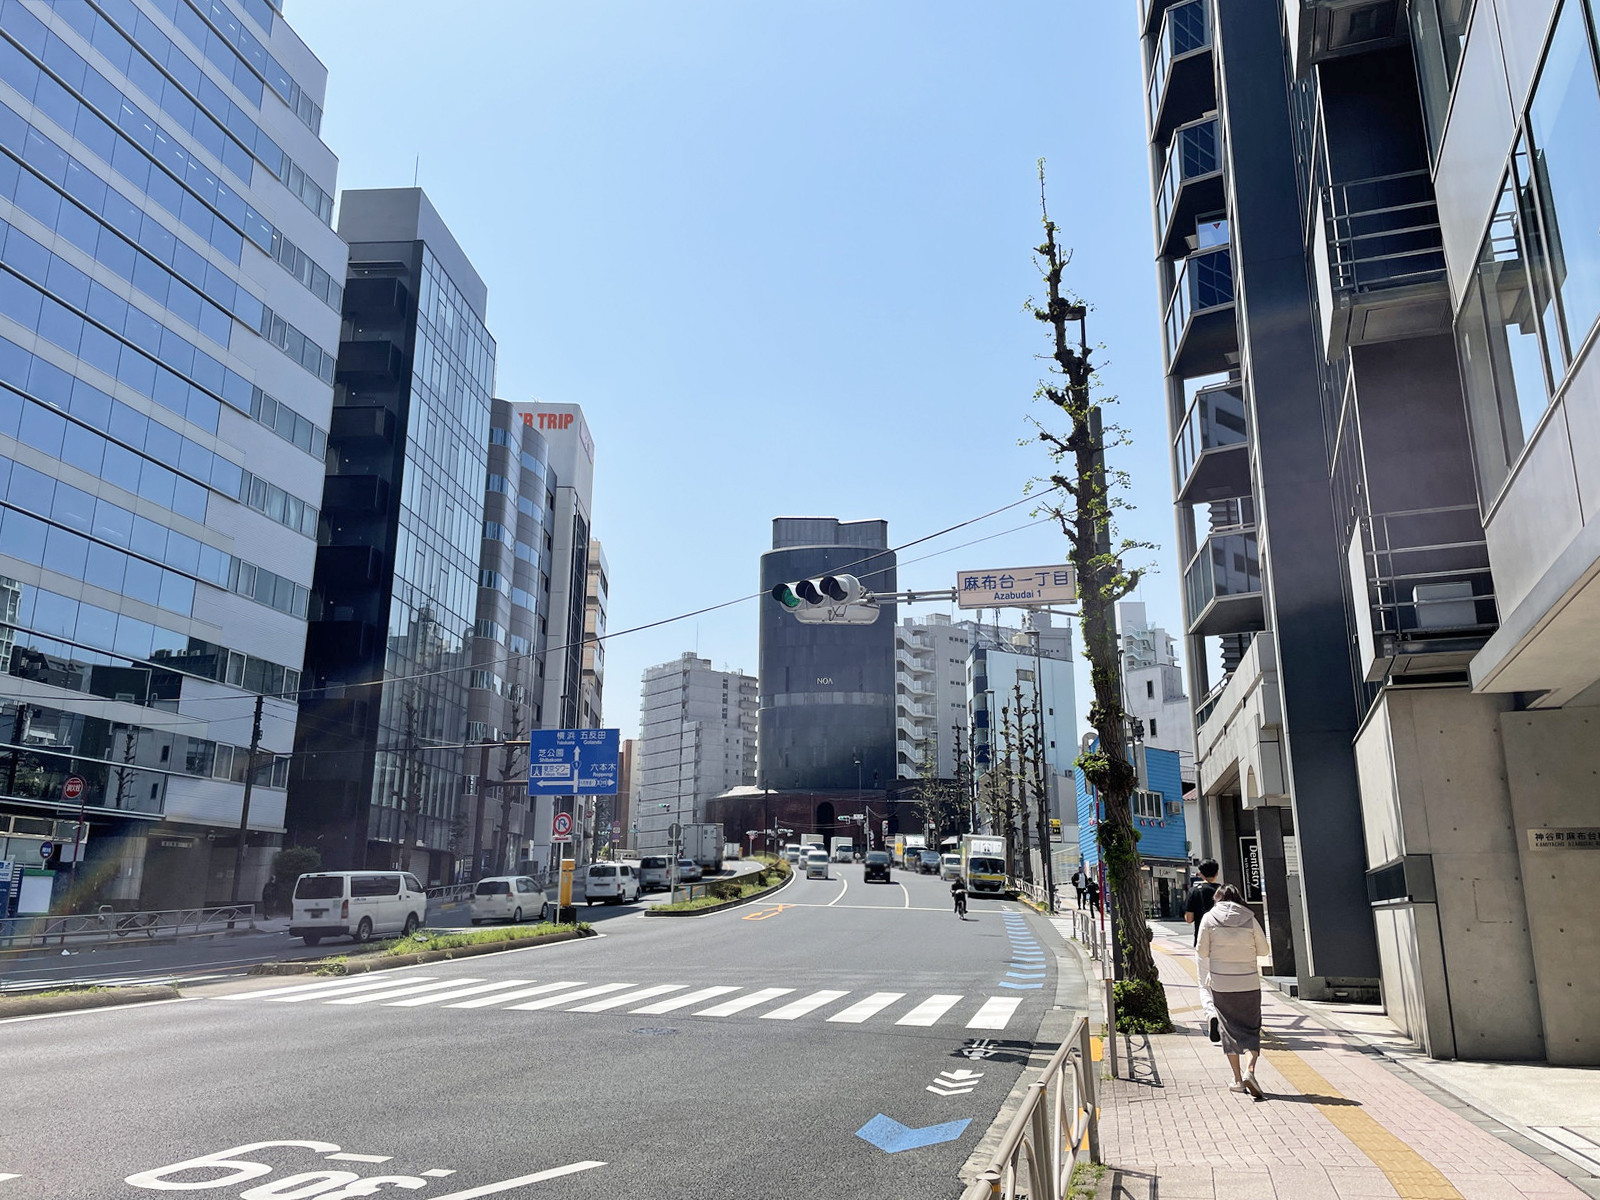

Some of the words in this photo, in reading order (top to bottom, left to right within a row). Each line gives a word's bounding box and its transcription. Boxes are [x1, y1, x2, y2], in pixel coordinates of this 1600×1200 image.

[537, 413, 574, 429] TRIP
[963, 571, 1068, 591] 麻布台一丁目
[994, 590, 1034, 600] Azabudai
[1037, 589, 1042, 598] 1
[556, 731, 576, 740] 横浜
[580, 731, 606, 740] 五反田
[538, 748, 564, 757] 芝公園
[543, 765, 570, 773] 東京タワー
[590, 763, 616, 771] 六本木
[1535, 832, 1600, 841] 神谷町麻布台
[1249, 845, 1259, 888] Dentistry
